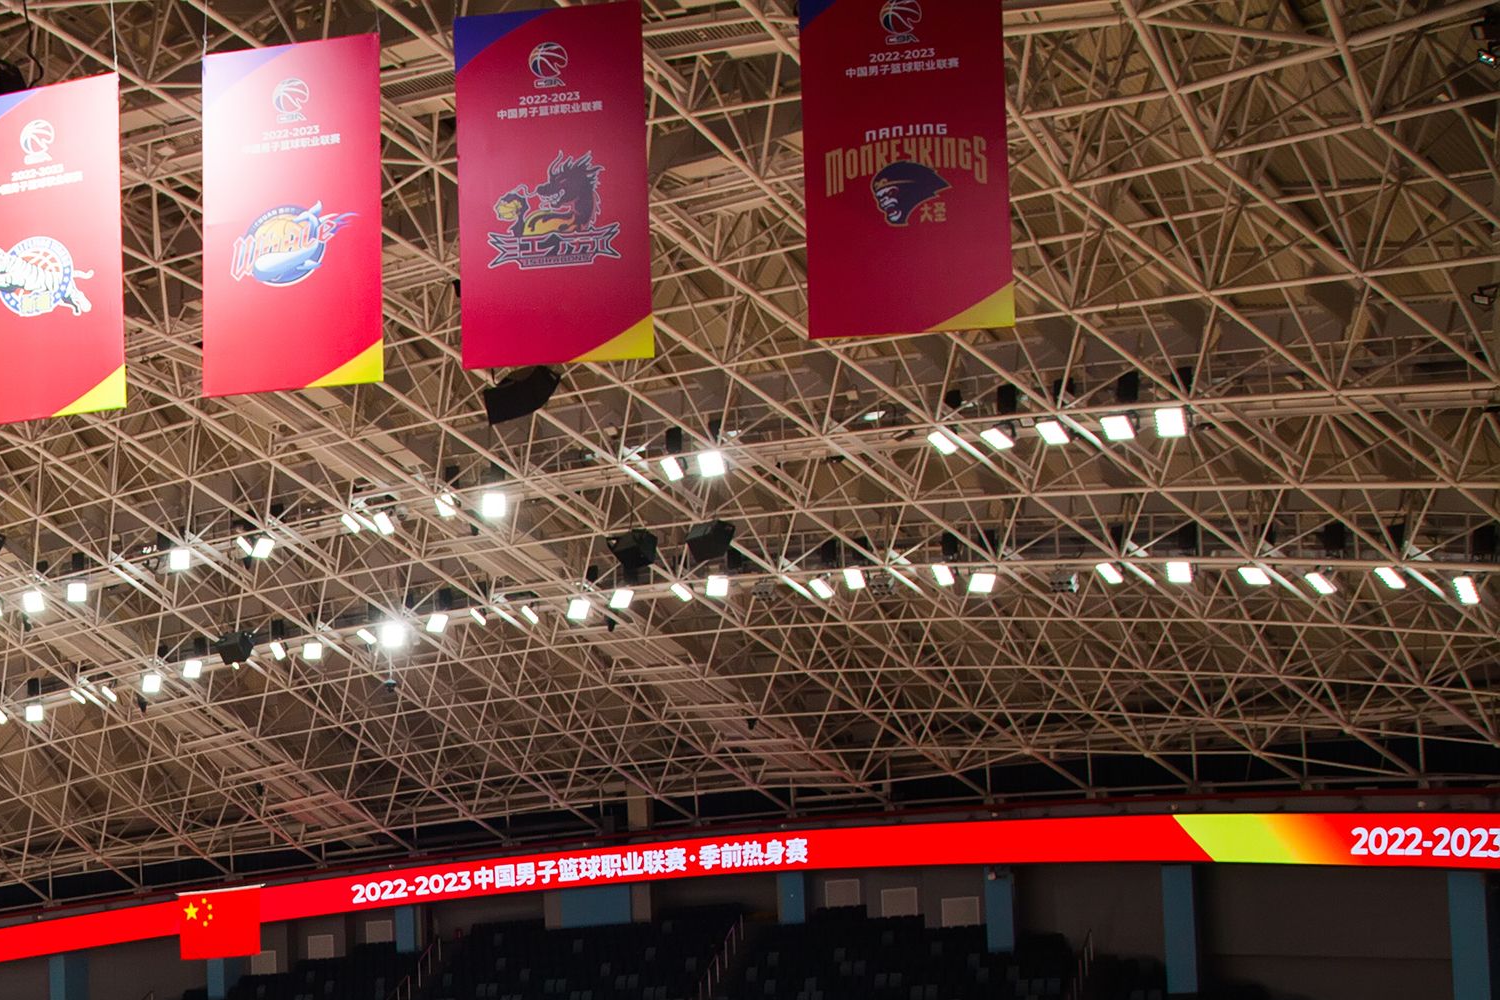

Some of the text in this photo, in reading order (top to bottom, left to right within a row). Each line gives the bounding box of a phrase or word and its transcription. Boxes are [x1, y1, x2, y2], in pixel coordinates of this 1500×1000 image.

[869, 48, 935, 63] 2022-2023
[845, 57, 960, 79] 中国男子篮球职业联赛
[519, 91, 580, 106] 2022-2023
[496, 100, 603, 120] 中国男子篮球职业联赛
[920, 202, 947, 223] 大圣
[1350, 827, 1500, 858] 2022-2023
